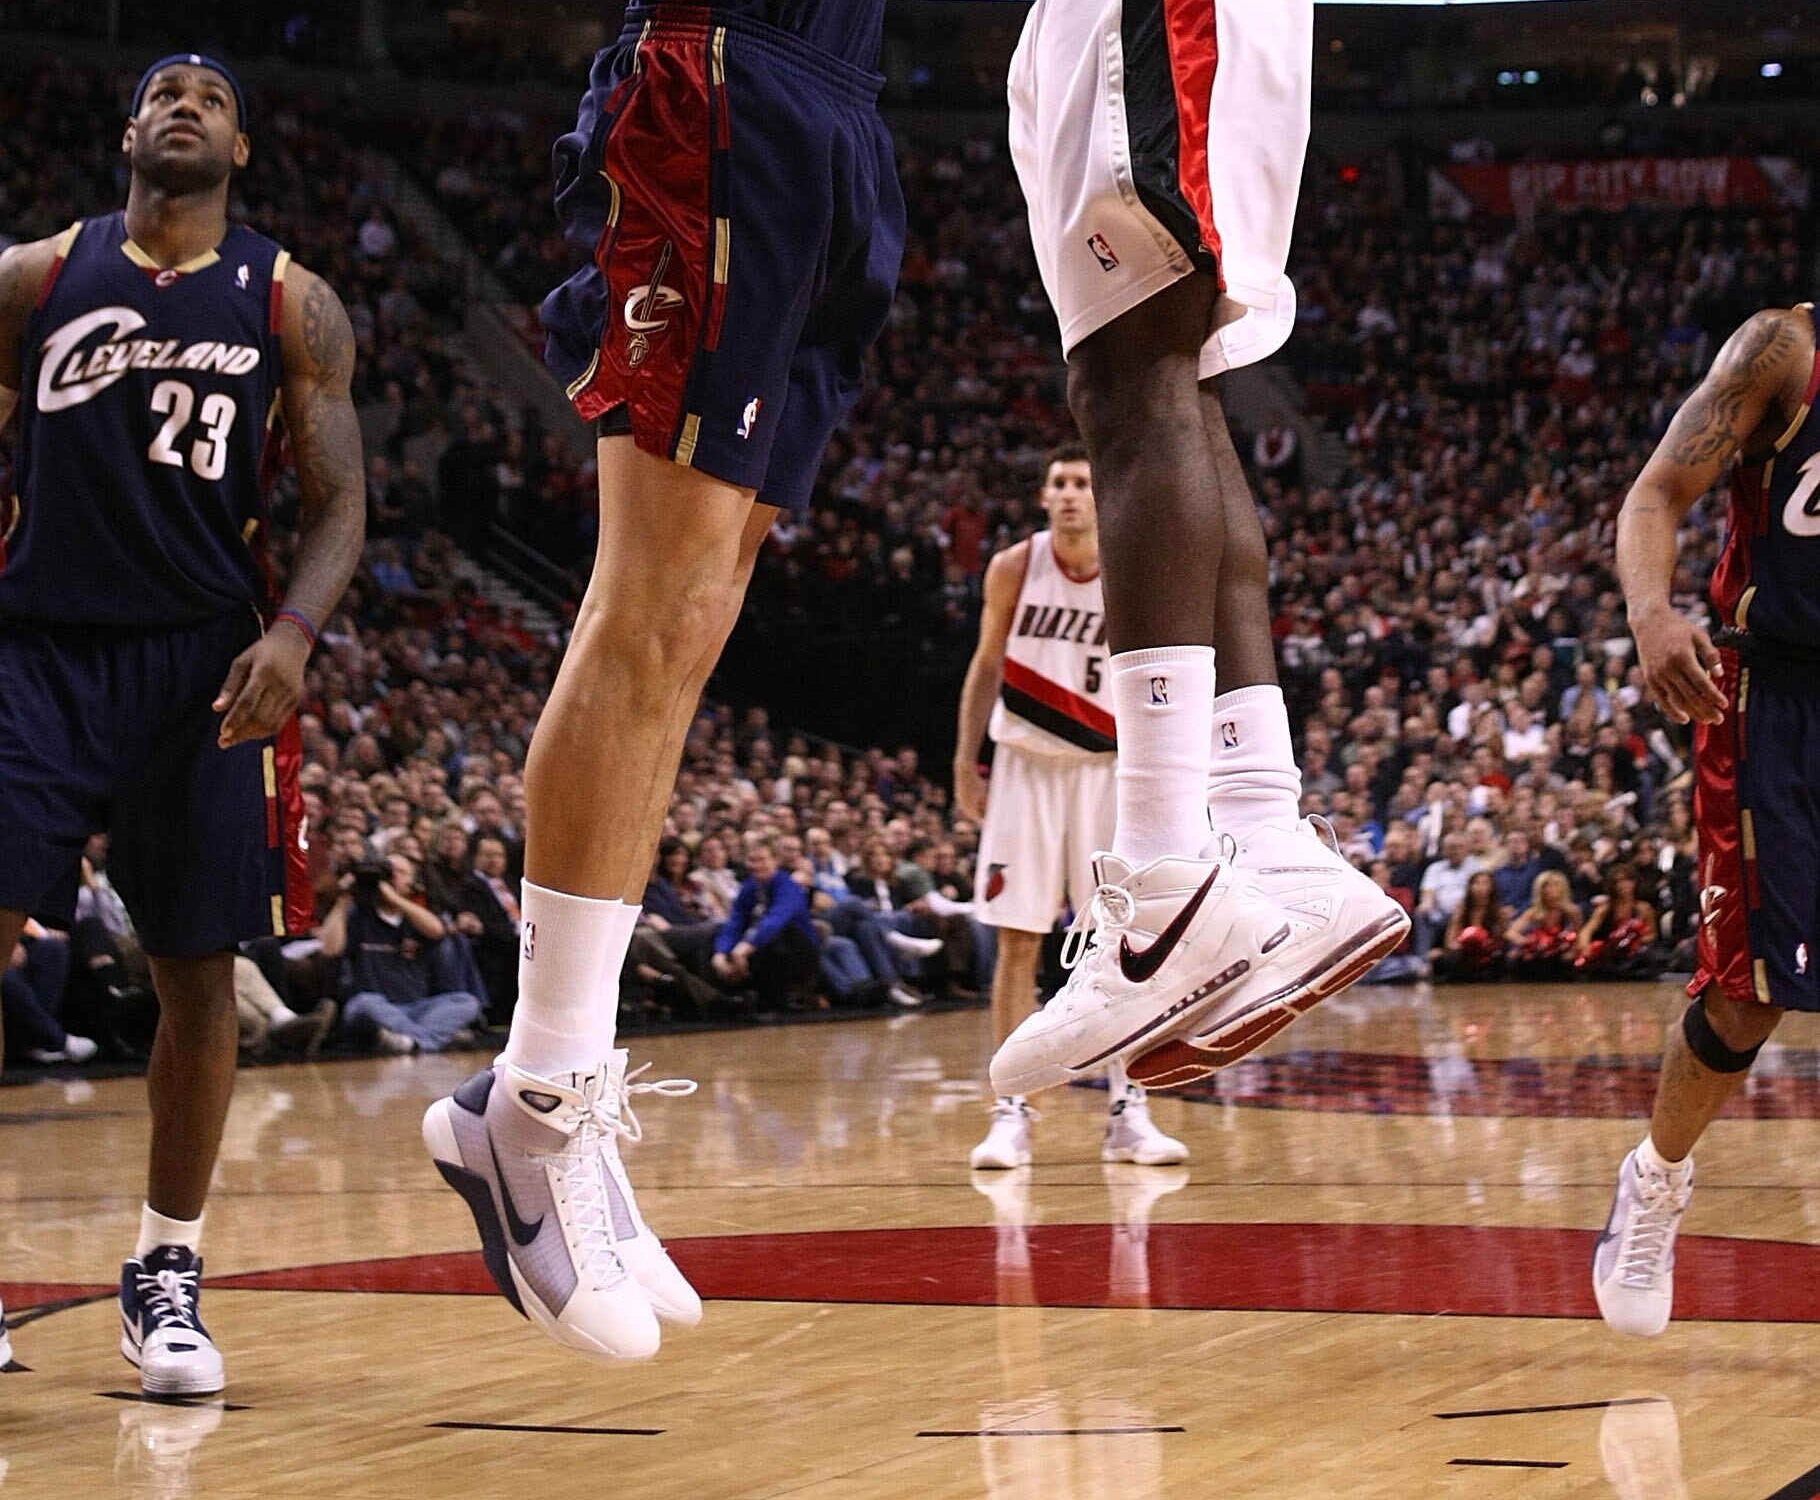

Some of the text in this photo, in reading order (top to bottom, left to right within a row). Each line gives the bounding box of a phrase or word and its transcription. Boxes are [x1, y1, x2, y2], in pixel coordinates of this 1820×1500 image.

[1573, 159, 1646, 196] CITY
[1653, 156, 1729, 196] ROW
[37, 306, 261, 414] CLEVELAND
[148, 380, 238, 482] 23
[1086, 656, 1103, 694] 5
